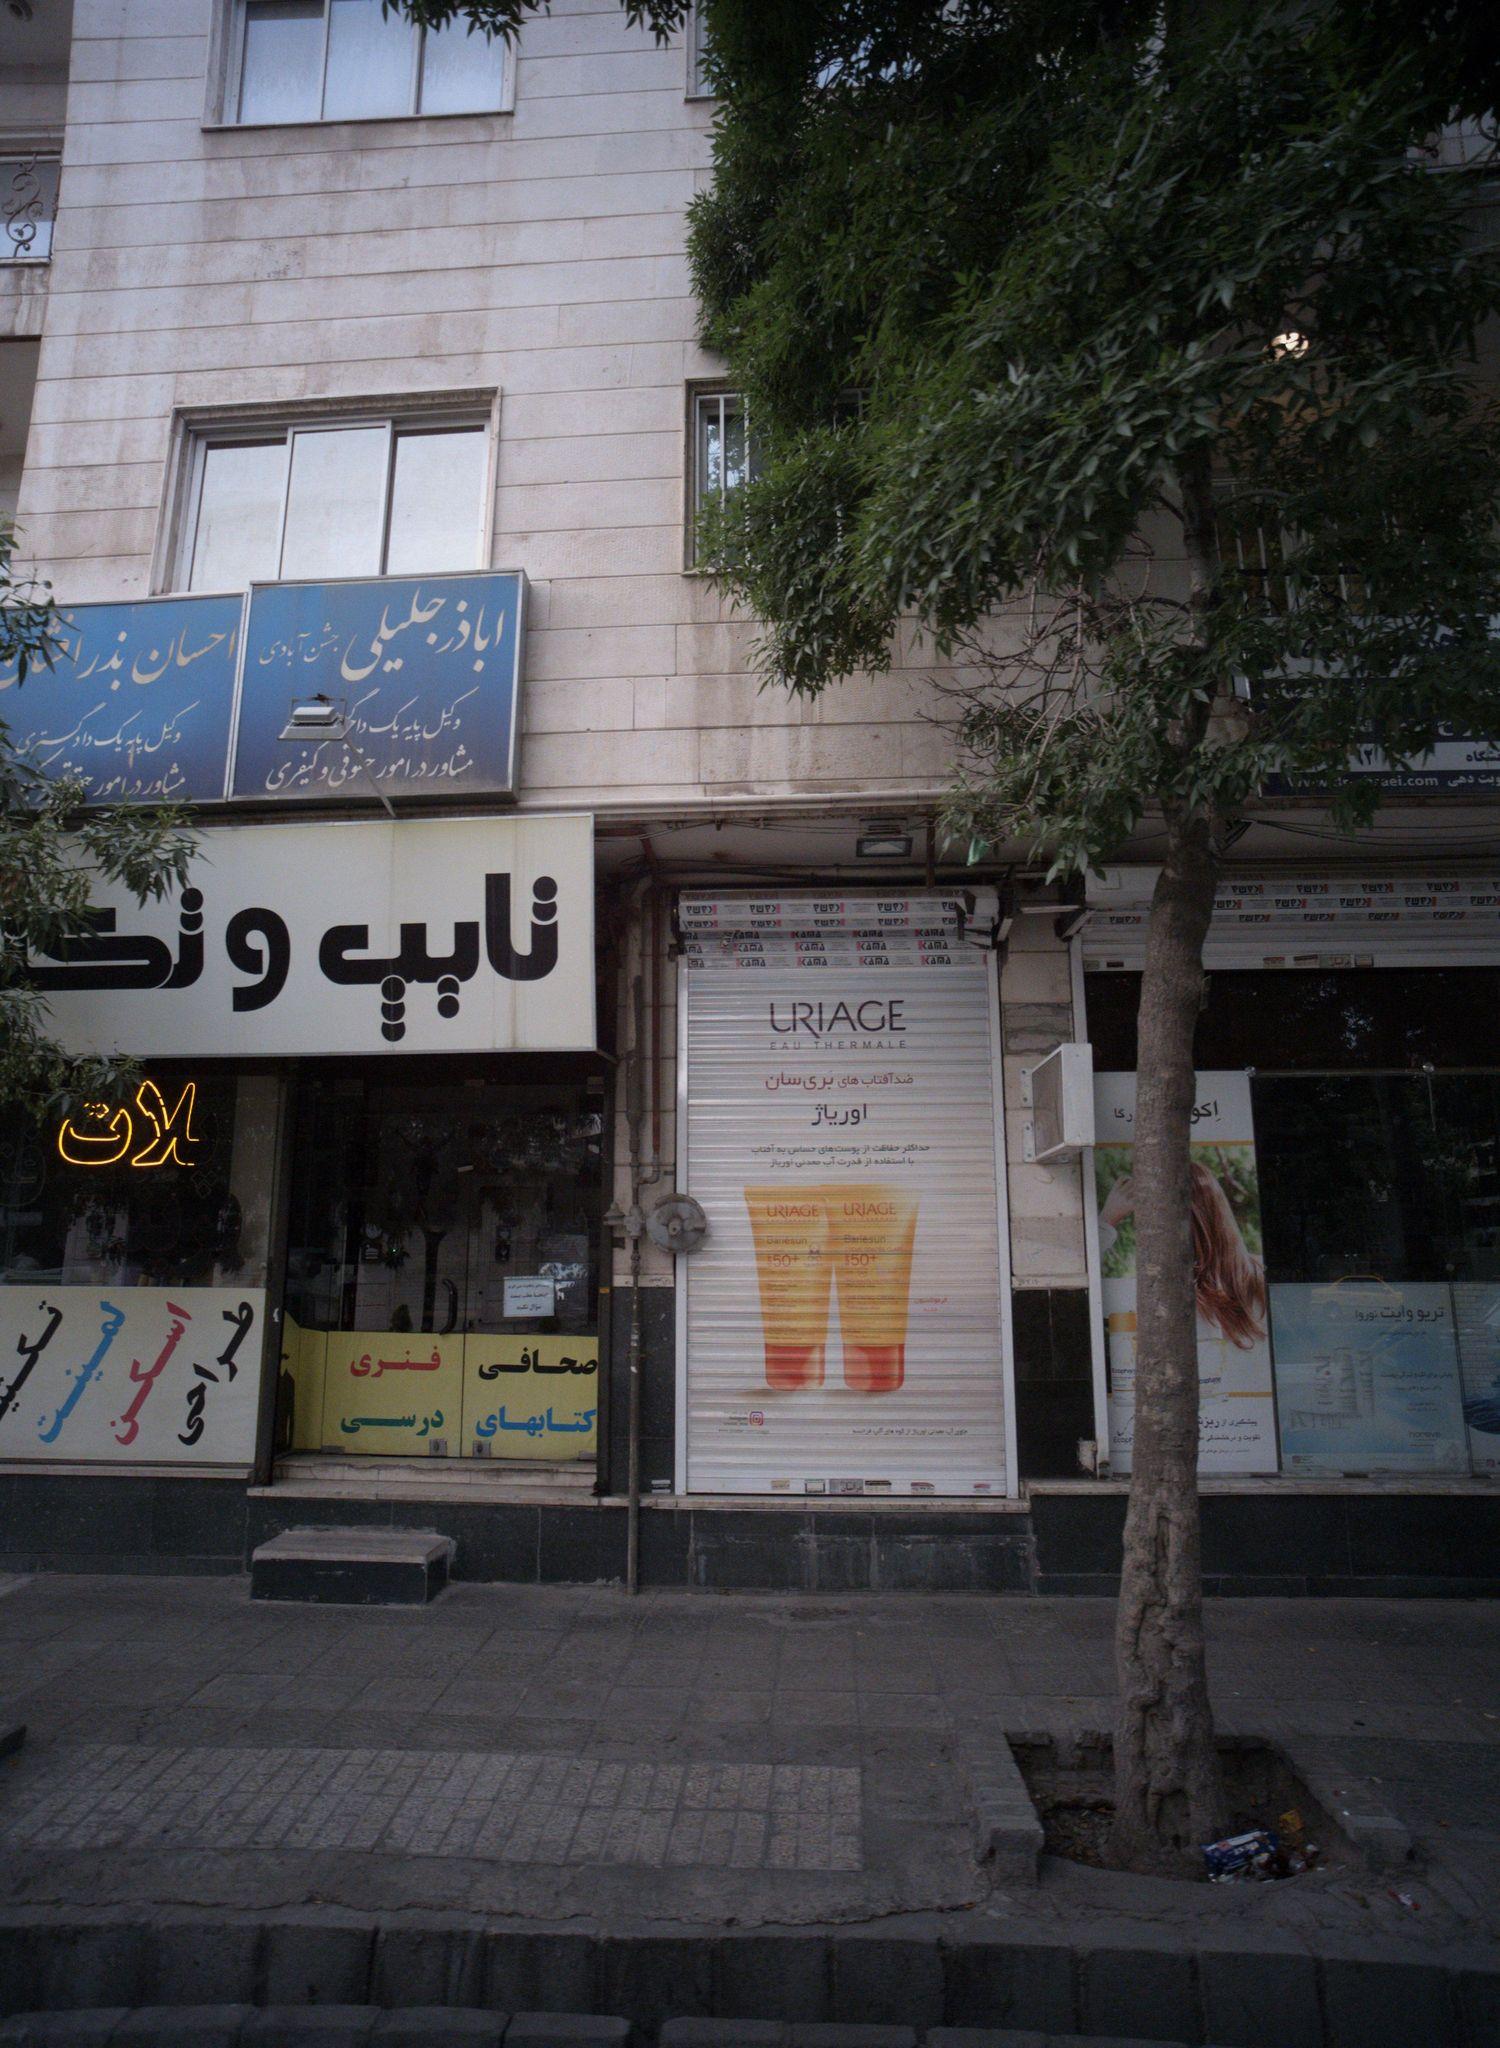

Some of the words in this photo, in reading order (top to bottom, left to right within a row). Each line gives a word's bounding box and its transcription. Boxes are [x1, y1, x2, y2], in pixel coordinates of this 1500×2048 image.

[340, 587, 447, 682] جلیلی
[436, 600, 505, 672] اباذر
[131, 623, 238, 685] احسان
[15, 701, 107, 755] دادگستری
[144, 699, 201, 753] وکیل
[369, 695, 419, 740] یک
[402, 716, 422, 741] پایه
[423, 686, 480, 740] وکیل
[94, 709, 143, 753] یک
[124, 732, 143, 753] پایه
[265, 740, 330, 791] کیفری
[376, 757, 411, 779] امور
[411, 759, 426, 778] در
[431, 743, 474, 778] مشاور
[92, 775, 127, 797] امور
[129, 779, 142, 795] در
[142, 762, 186, 795] مشاور
[318, 872, 558, 1042] تایپ
[769, 1000, 907, 1039] URIAGE
[769, 1041, 801, 1050] EAU
[814, 1040, 907, 1050] THERMALE
[837, 1076, 859, 1089] های
[811, 1103, 867, 1125] اوریاژ
[766, 1204, 819, 1219] URIAGE
[843, 1202, 897, 1216] URIAGE
[38, 1301, 126, 1444] لمینت
[115, 1301, 192, 1446] اسکن
[178, 1301, 254, 1446] طراحی
[350, 1345, 441, 1378] فنری
[478, 1347, 598, 1380] صحافی
[340, 1409, 445, 1436] درسی
[475, 1405, 598, 1439] کتابهای
